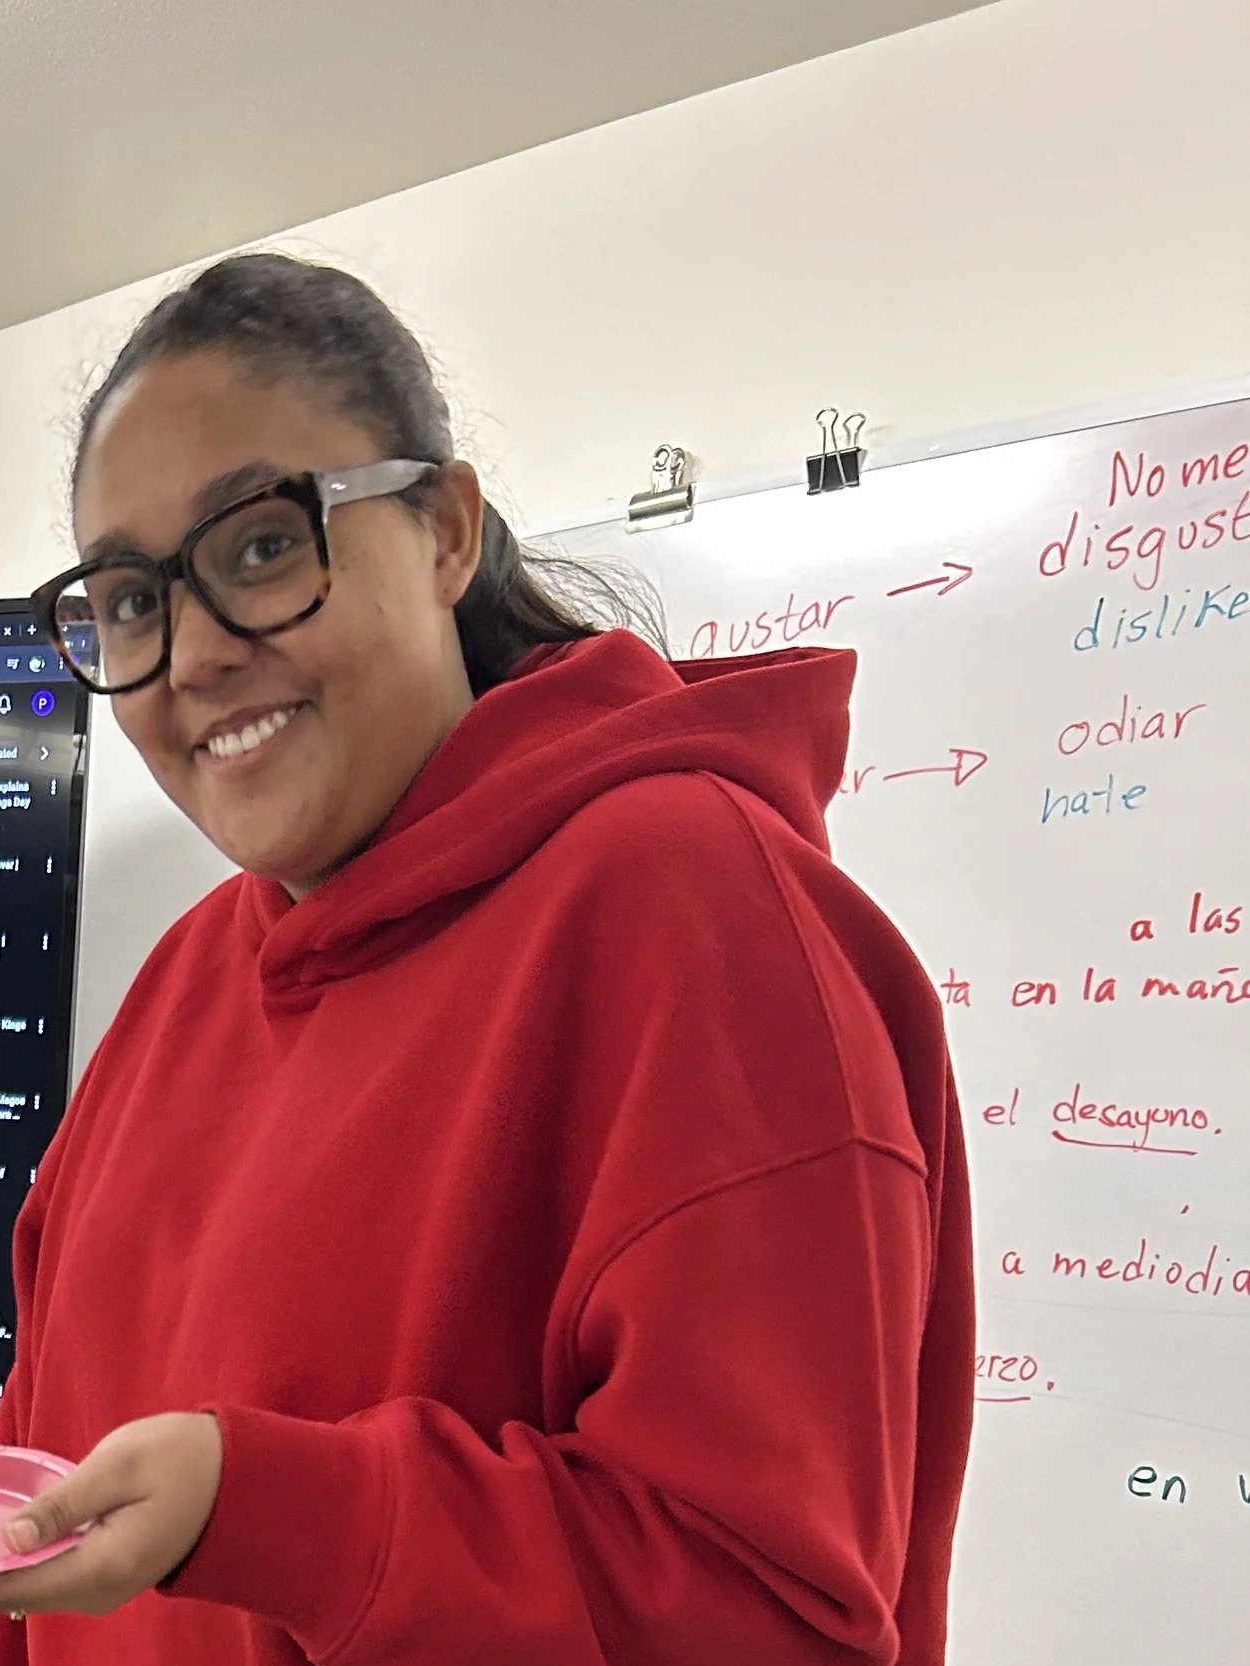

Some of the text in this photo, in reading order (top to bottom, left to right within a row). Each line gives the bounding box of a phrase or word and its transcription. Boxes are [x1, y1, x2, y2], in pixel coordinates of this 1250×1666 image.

[1108, 444, 1249, 507] No me
[1073, 584, 1250, 651] dislike
[38, 697, 47, 709] P
[1058, 694, 1207, 755] odiar
[13, 796, 31, 809] Day
[1040, 773, 1147, 824] hate
[1130, 892, 1243, 941] a las
[1012, 981, 1056, 1007] en
[1083, 967, 1117, 1003] la
[983, 1088, 1019, 1125] el
[1002, 1251, 1025, 1275] a
[1127, 1465, 1187, 1503] en
